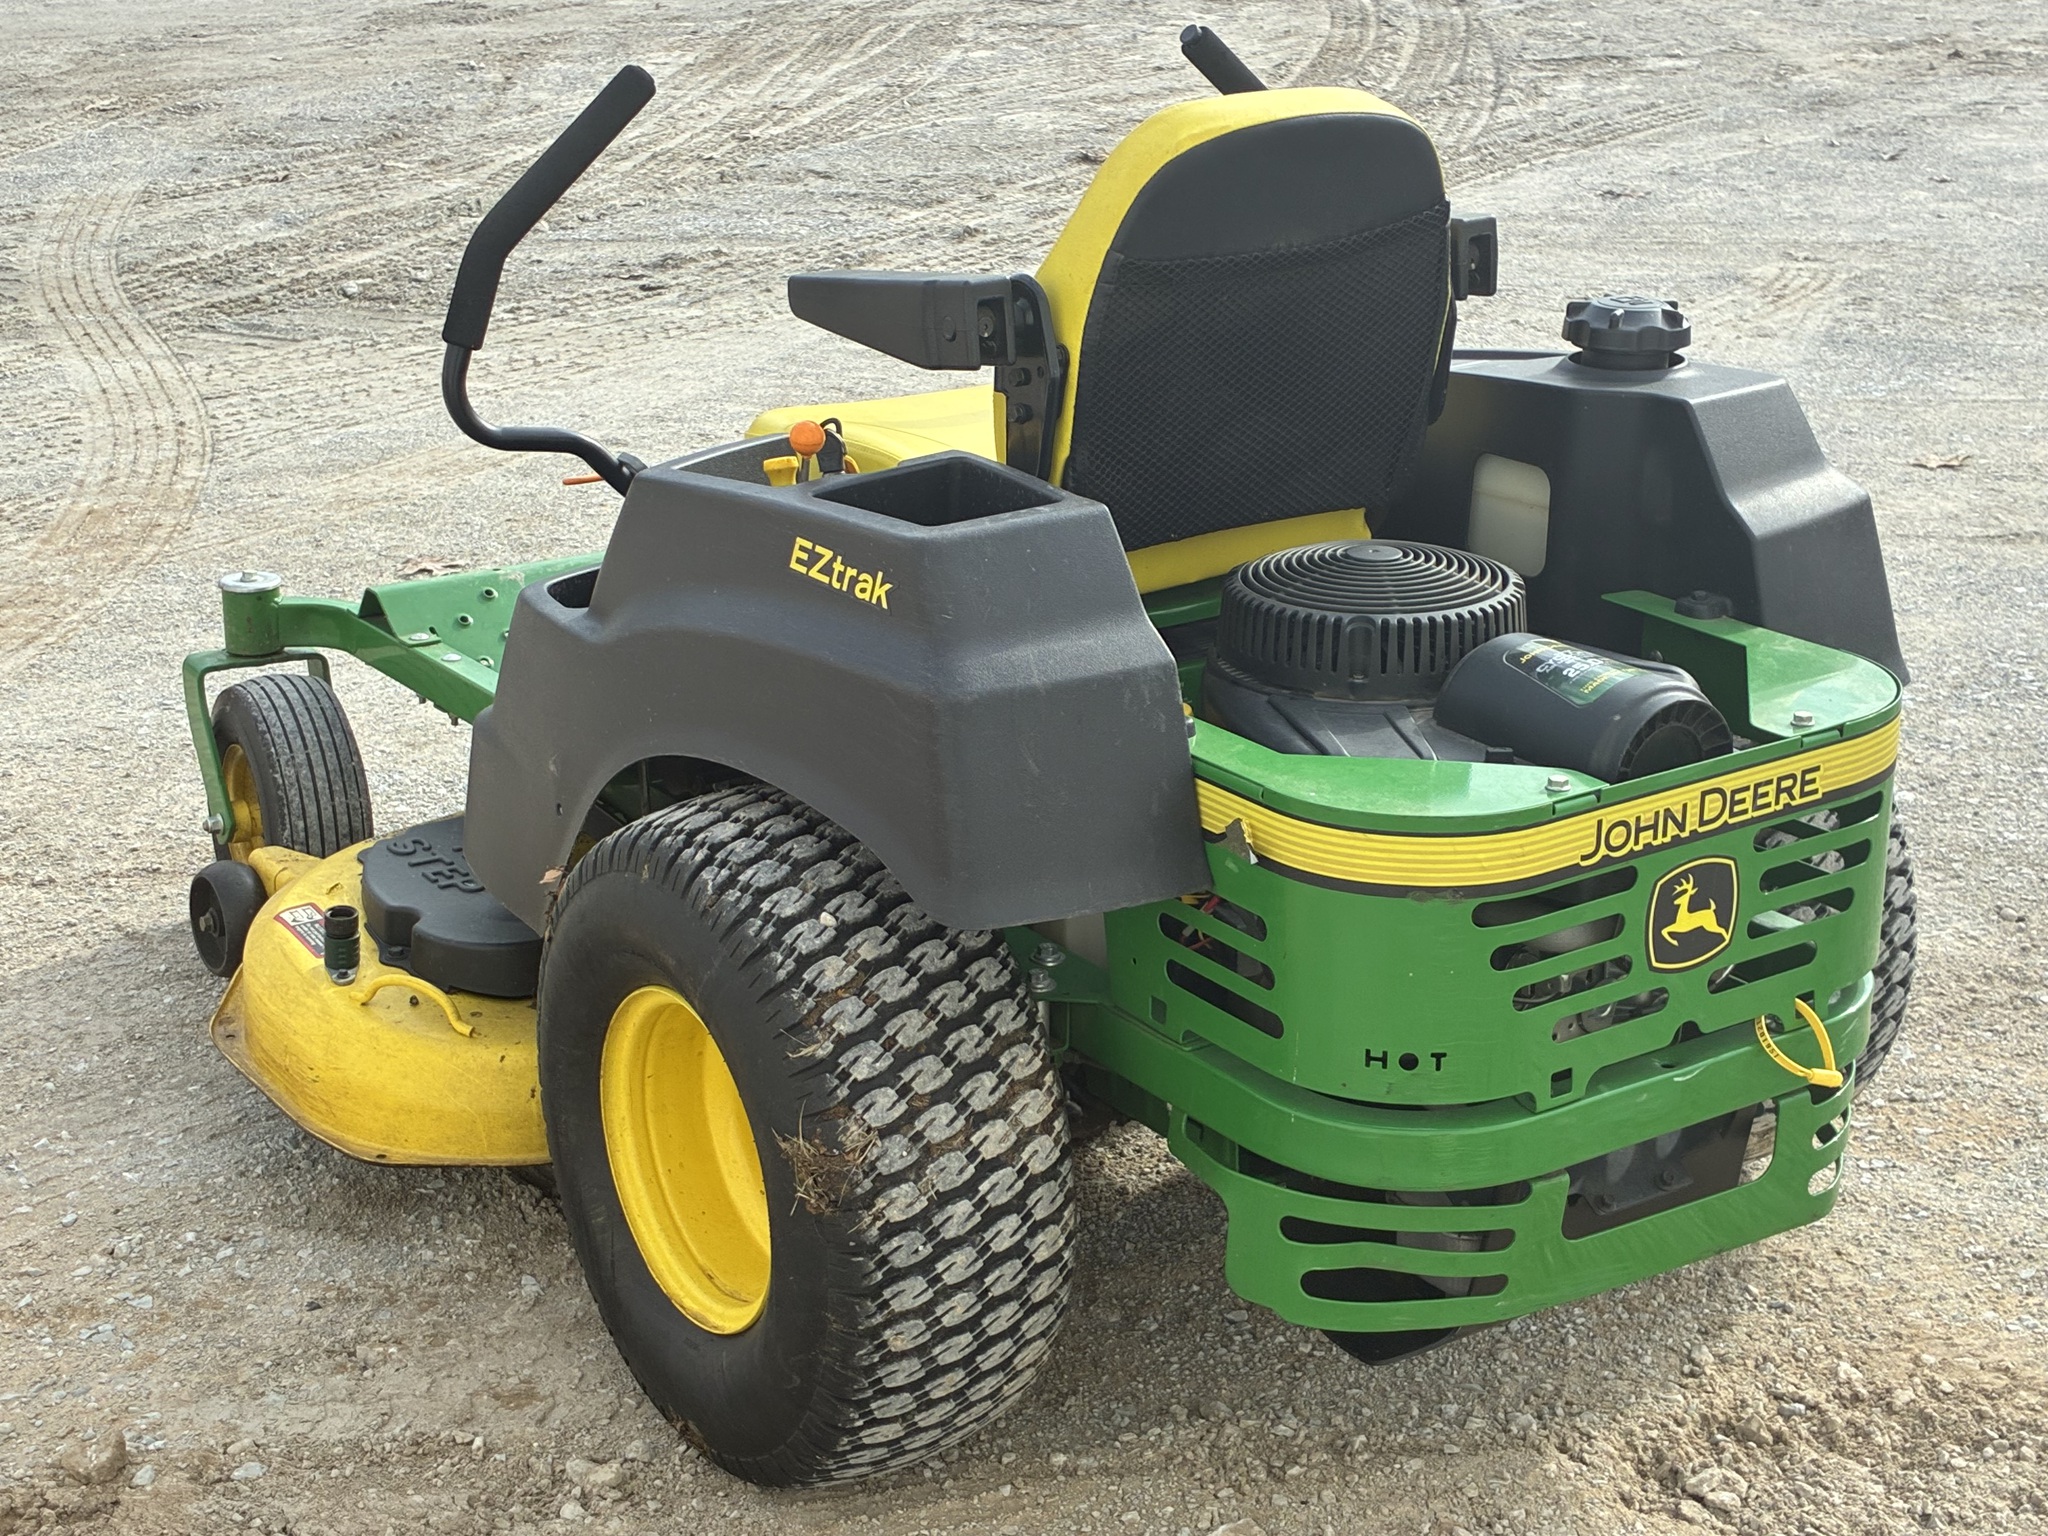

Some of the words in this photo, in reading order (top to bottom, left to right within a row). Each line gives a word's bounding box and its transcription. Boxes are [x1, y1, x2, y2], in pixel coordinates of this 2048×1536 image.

[789, 536, 893, 609] EZtrak
[1580, 803, 1687, 862] JOHN
[1699, 765, 1821, 827] DEERE
[387, 838, 486, 892] STEP
[1365, 1049, 1447, 1072] HOT
